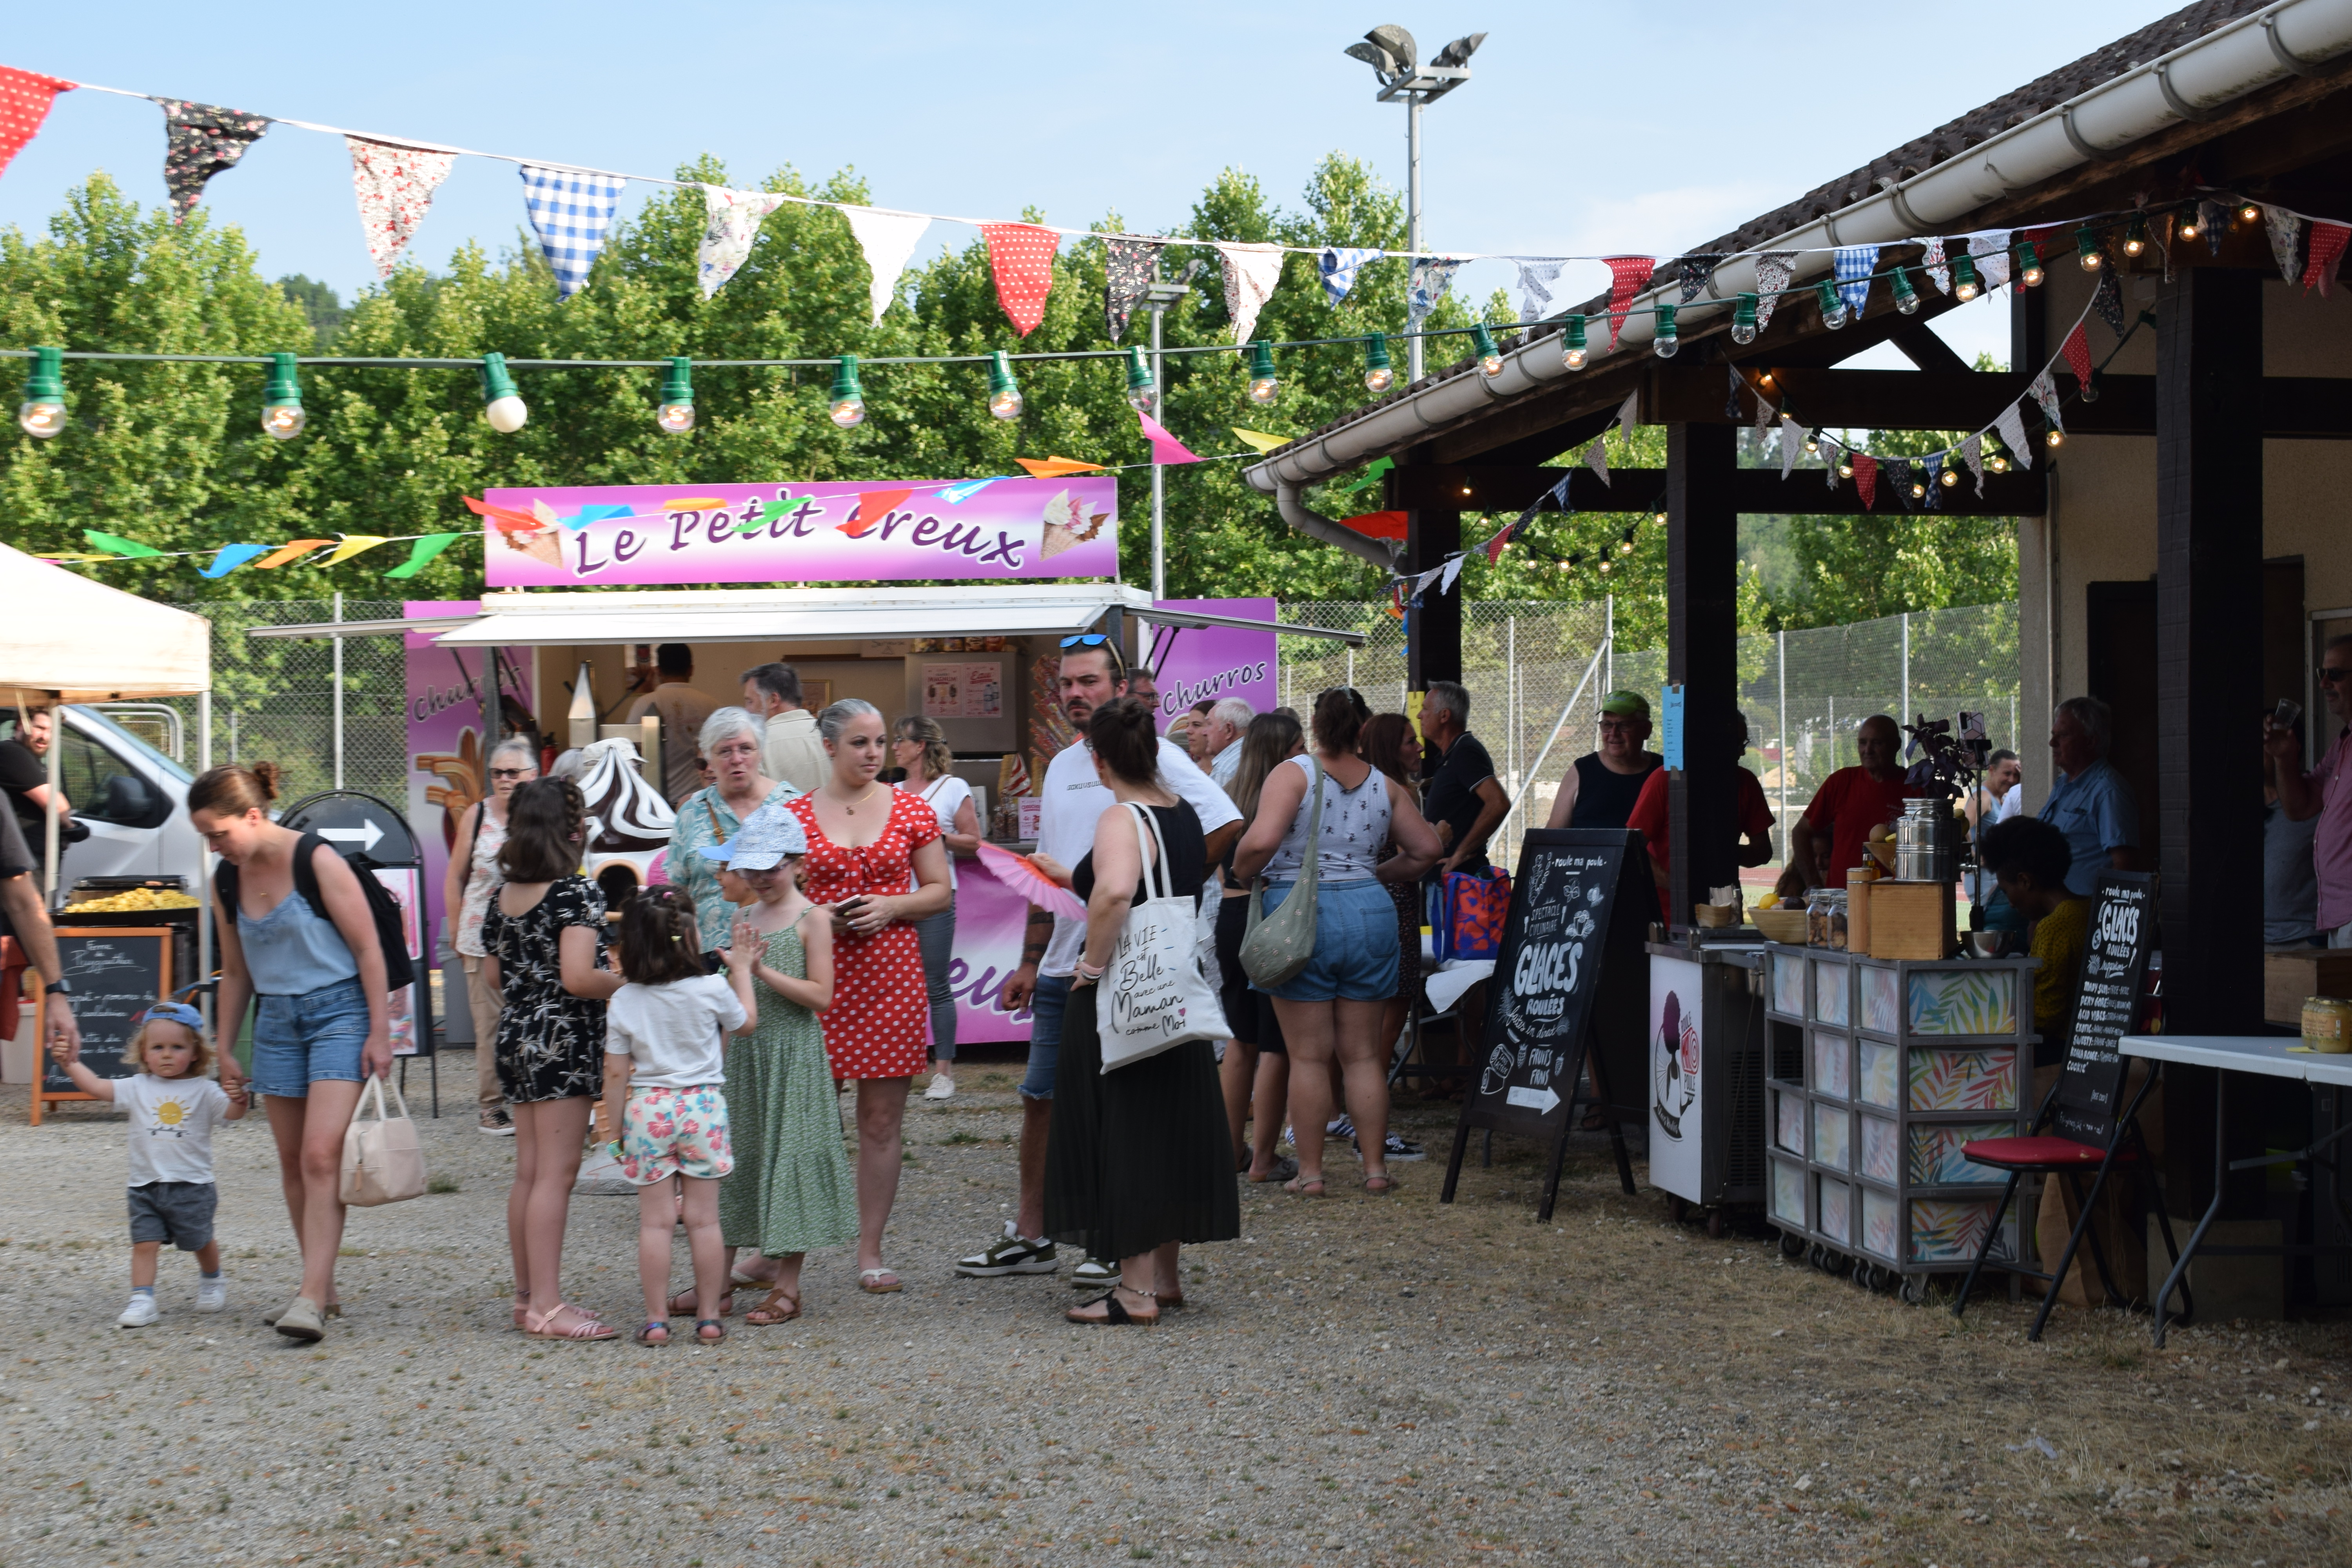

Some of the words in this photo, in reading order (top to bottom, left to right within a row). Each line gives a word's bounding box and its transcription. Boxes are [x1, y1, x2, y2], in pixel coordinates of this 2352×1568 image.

[575, 530, 648, 575] Le
[669, 490, 825, 551] Petit
[1162, 662, 1267, 717] Churros
[1554, 854, 1573, 867] roule
[1573, 857, 1584, 866] ma
[1585, 855, 1604, 871] poule
[2105, 885, 2120, 897] roule
[2121, 889, 2130, 899] ma
[2129, 888, 2143, 905] poule
[1531, 903, 1561, 921] SPECTACLE
[1529, 919, 1558, 937] CULINAIRE
[2102, 904, 2140, 945] GLACES
[1118, 935, 1132, 959] LA
[1134, 925, 1157, 947] VIE
[2106, 943, 2130, 958] ROULÉES
[1136, 946, 1150, 961] est
[1120, 953, 1164, 991] Belle
[1514, 941, 1583, 997] GLACES
[1134, 987, 1155, 999] avec
[1157, 980, 1175, 991] une
[1111, 990, 1183, 1034] Maman
[1525, 993, 1566, 1015] ROULÉES
[1125, 1022, 1160, 1036] comme
[1162, 1014, 1186, 1037] Moi
[1505, 1005, 1526, 1032] faites
[1524, 1025, 1536, 1038] en
[1536, 1023, 1557, 1039] direct
[1494, 1058, 1509, 1074] LACTOSE
[1498, 1053, 1509, 1065] SANS
[1528, 1048, 1554, 1067] FRUITS
[1530, 1068, 1551, 1086] FRAIS
